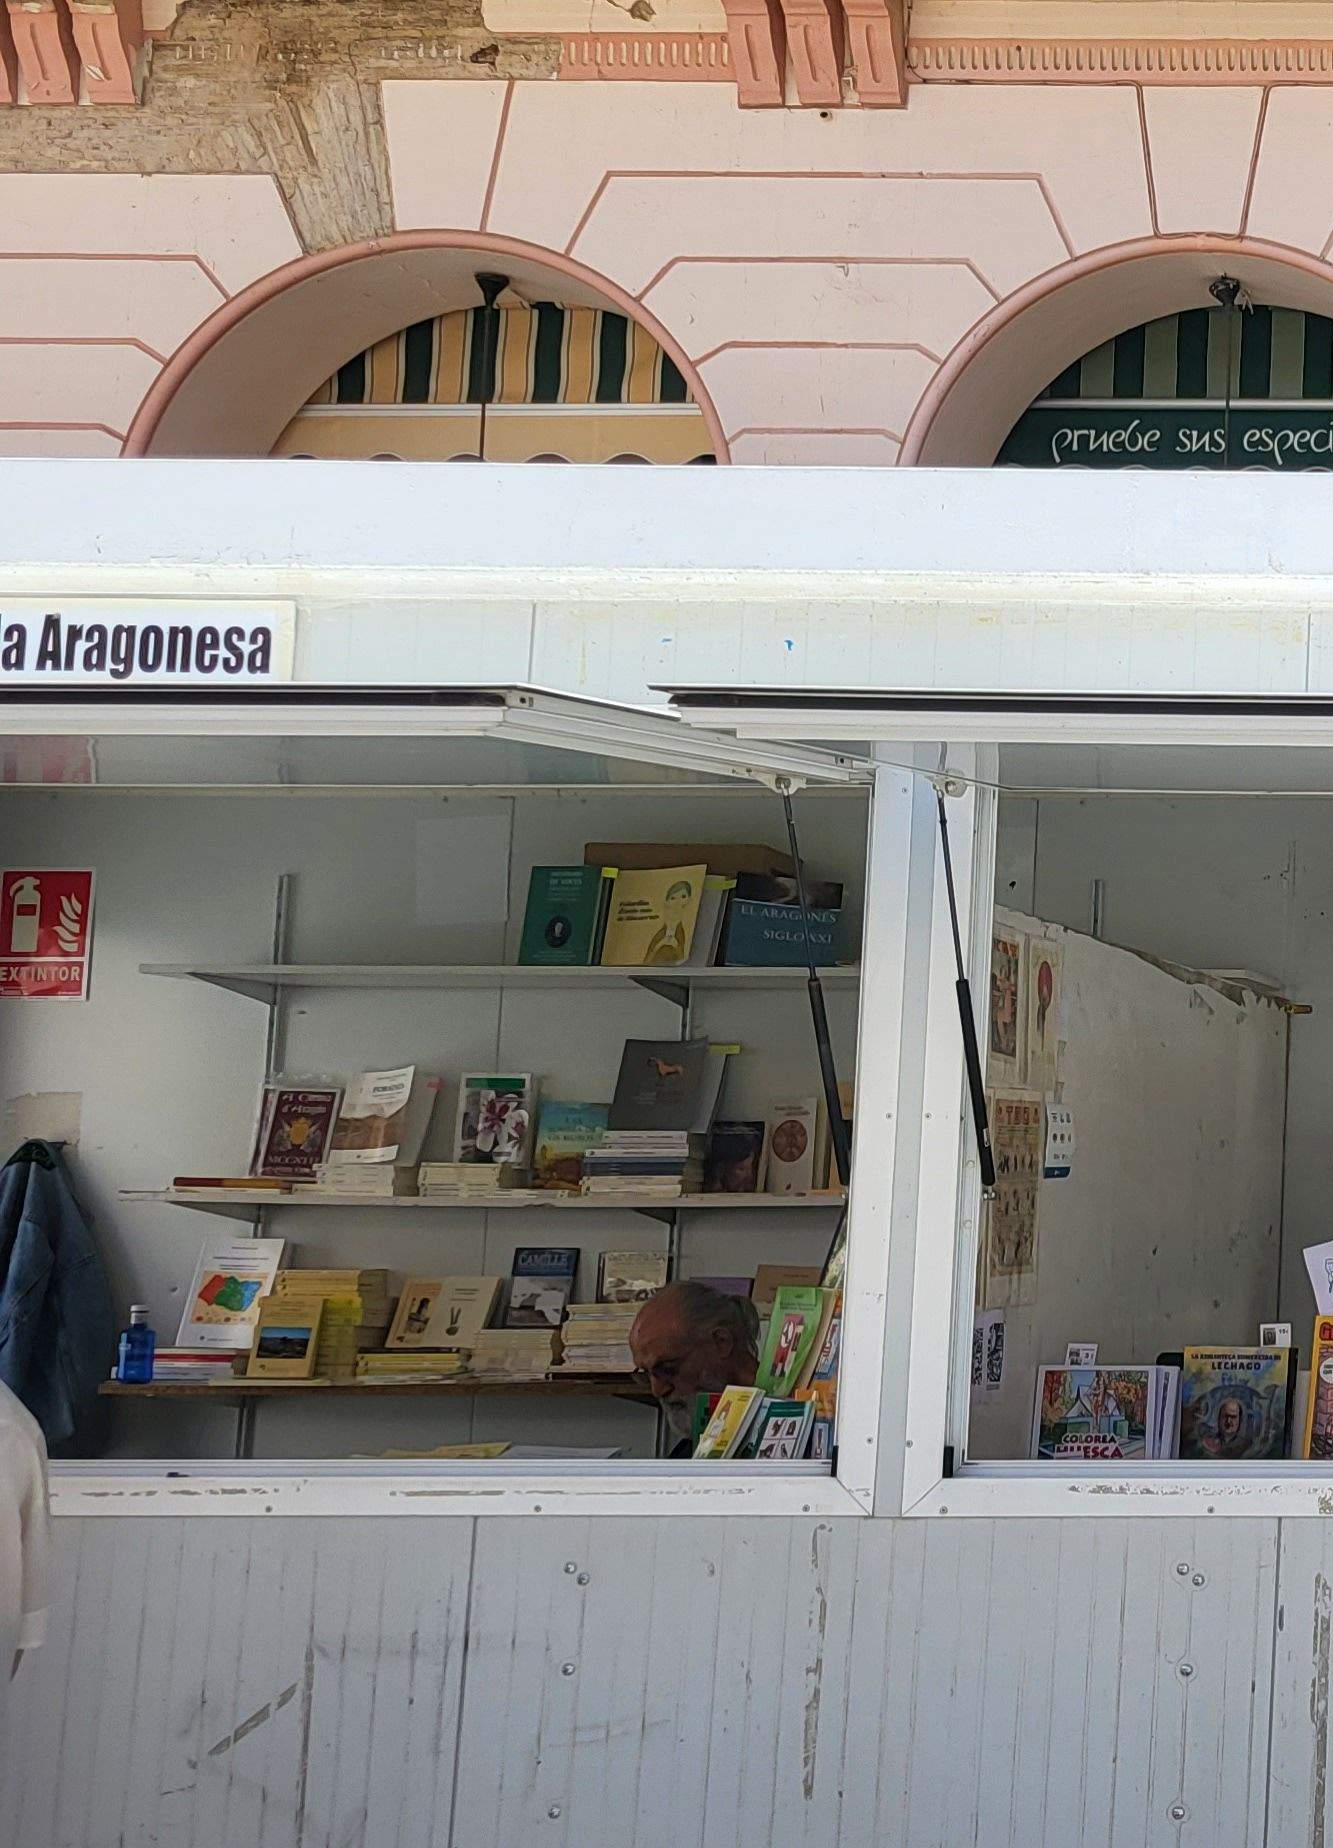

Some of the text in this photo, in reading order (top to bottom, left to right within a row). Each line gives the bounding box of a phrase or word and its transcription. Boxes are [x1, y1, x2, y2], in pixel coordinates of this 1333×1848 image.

[1052, 419, 1160, 464] pruebe
[1176, 428, 1226, 454] sus
[35, 613, 272, 680] Aragonesa
[0, 966, 80, 982] EXTINTOR
[1211, 1361, 1261, 1370] LECHAGO
[1062, 1433, 1117, 1445] COLOREA
